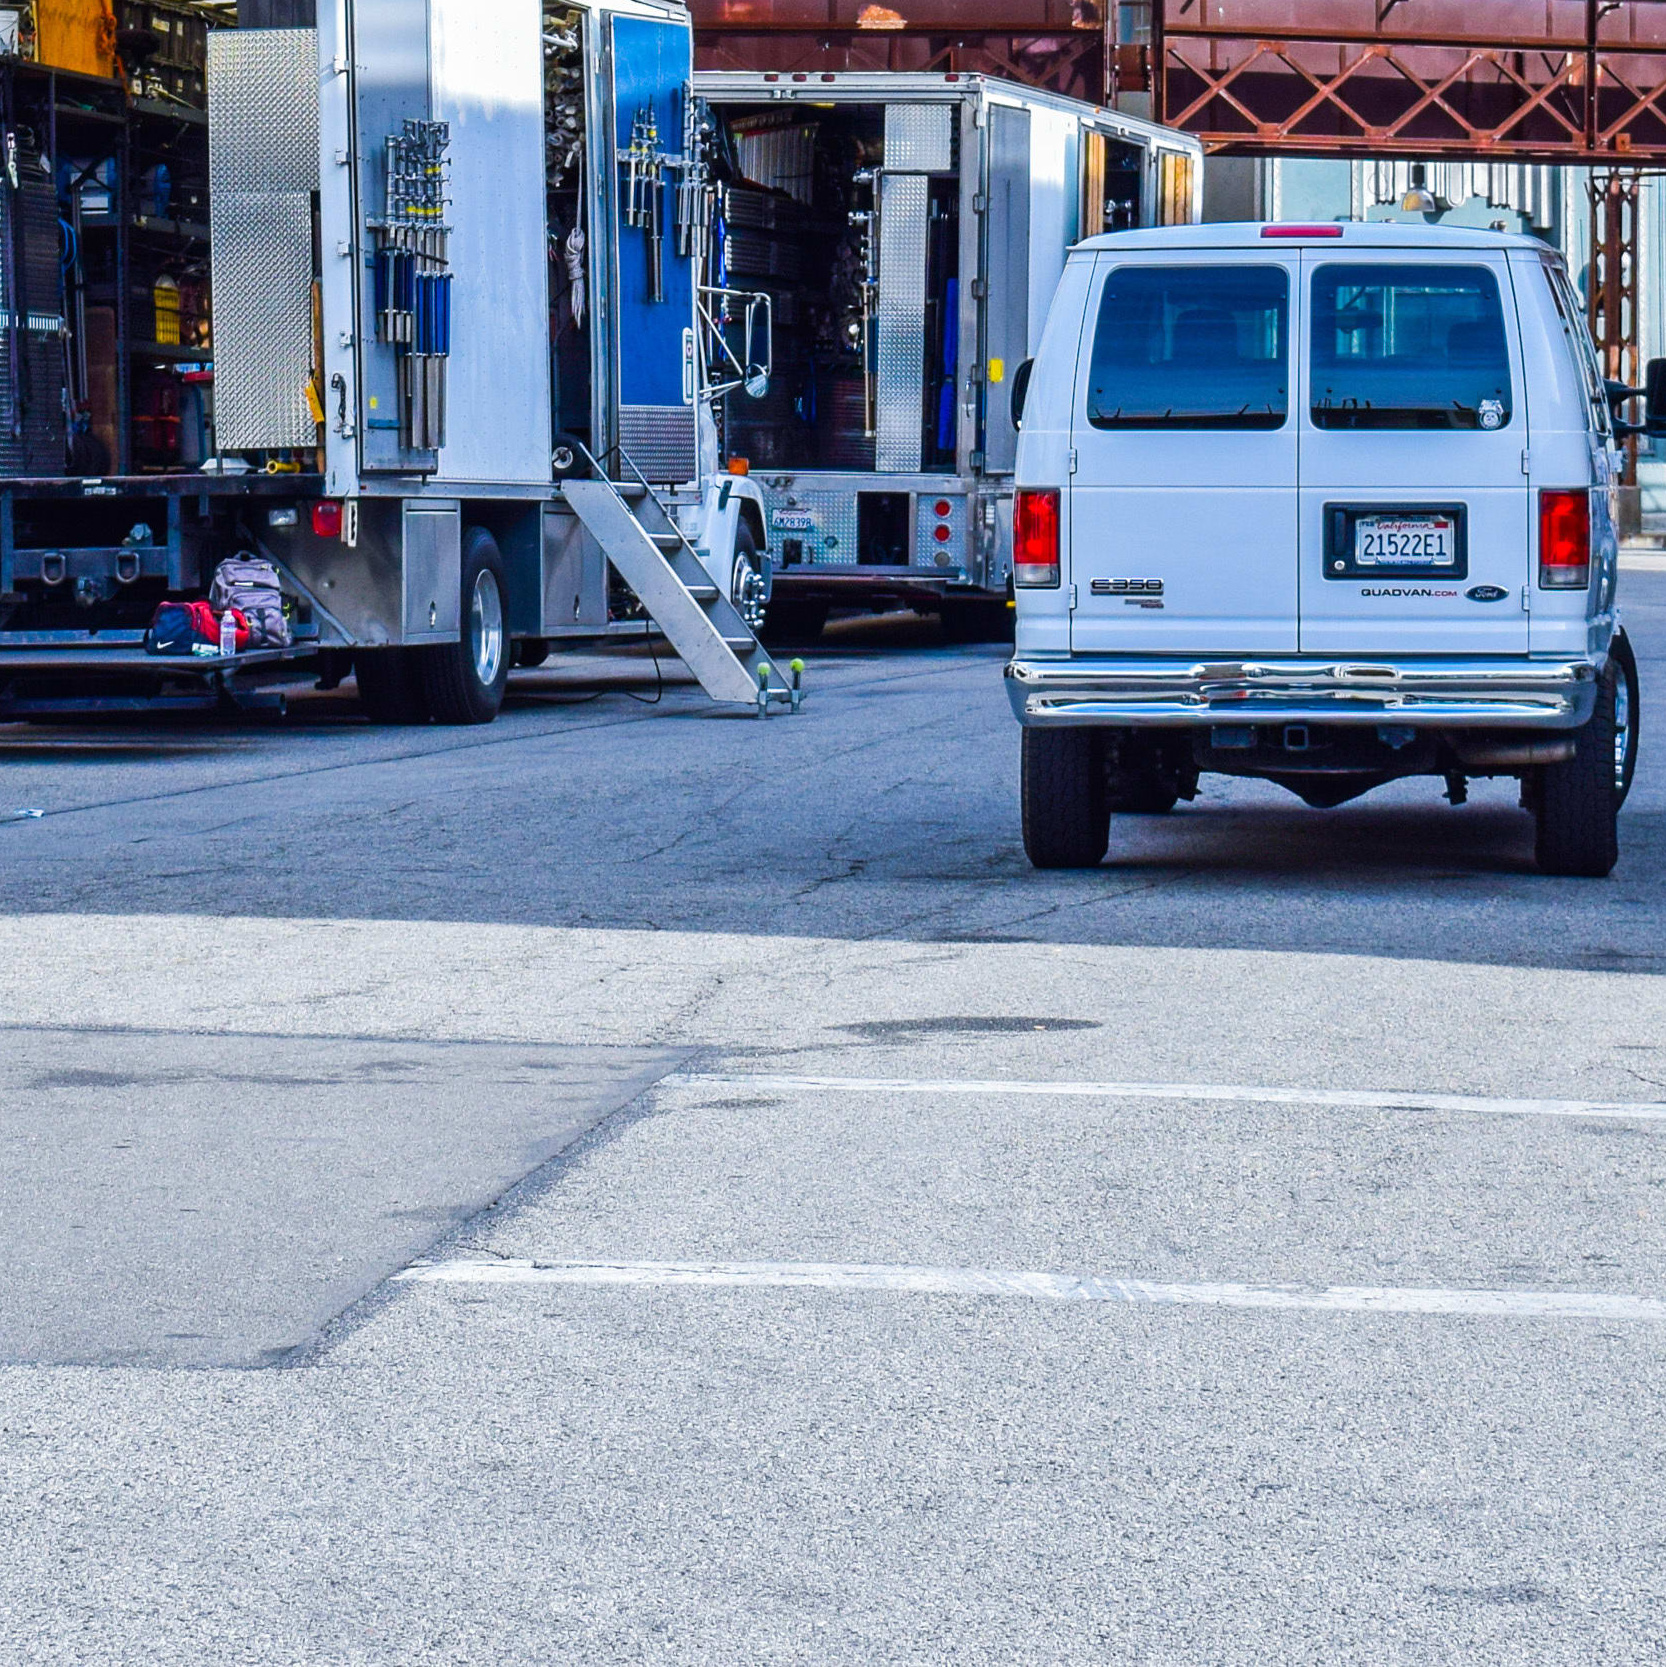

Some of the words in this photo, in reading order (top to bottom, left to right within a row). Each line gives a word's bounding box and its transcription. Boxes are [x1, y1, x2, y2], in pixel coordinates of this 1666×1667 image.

[1377, 520, 1434, 533] California
[1364, 533, 1447, 556] 21522E1
[1361, 588, 1457, 597] QUADVAN.COM
[1474, 587, 1499, 598] Ford
